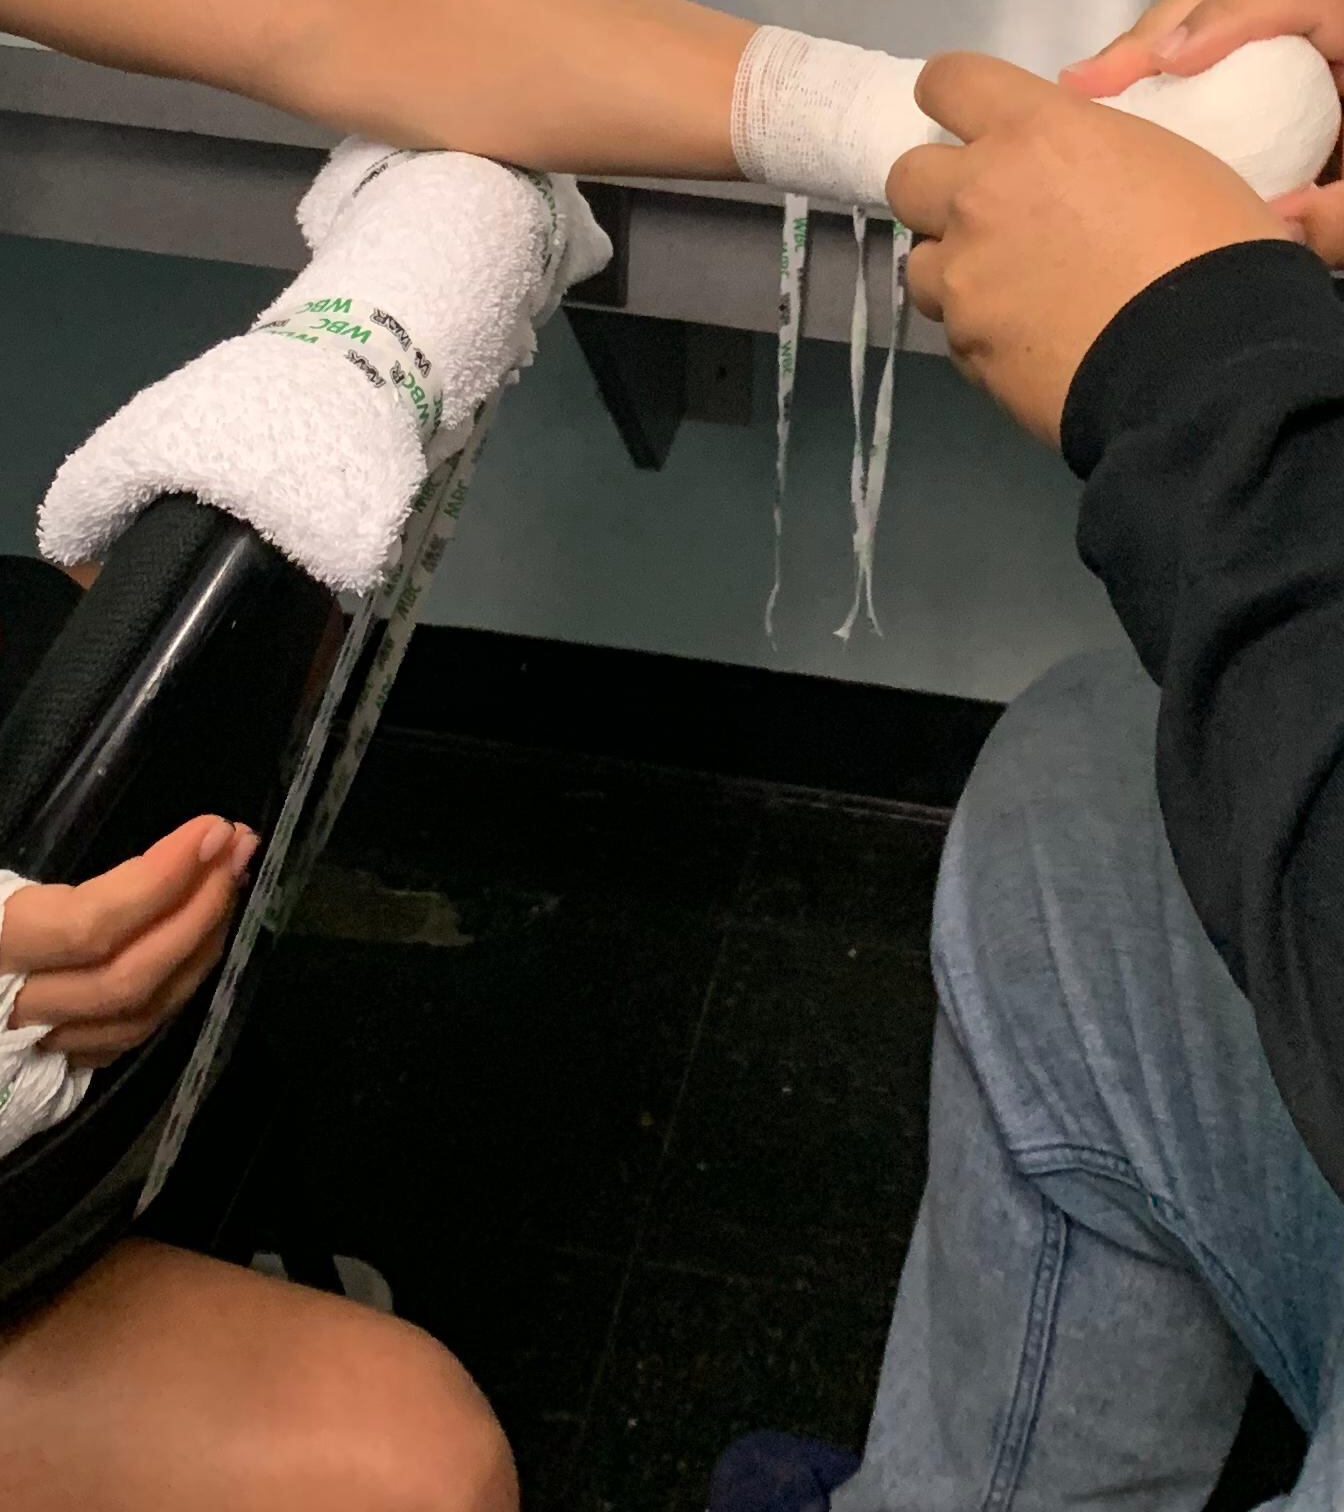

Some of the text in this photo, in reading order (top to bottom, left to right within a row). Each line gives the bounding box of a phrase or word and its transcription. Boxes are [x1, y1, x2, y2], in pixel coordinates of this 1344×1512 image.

[295, 298, 353, 315] WBC
[309, 318, 373, 345] WBC
[401, 372, 431, 429] WBC
